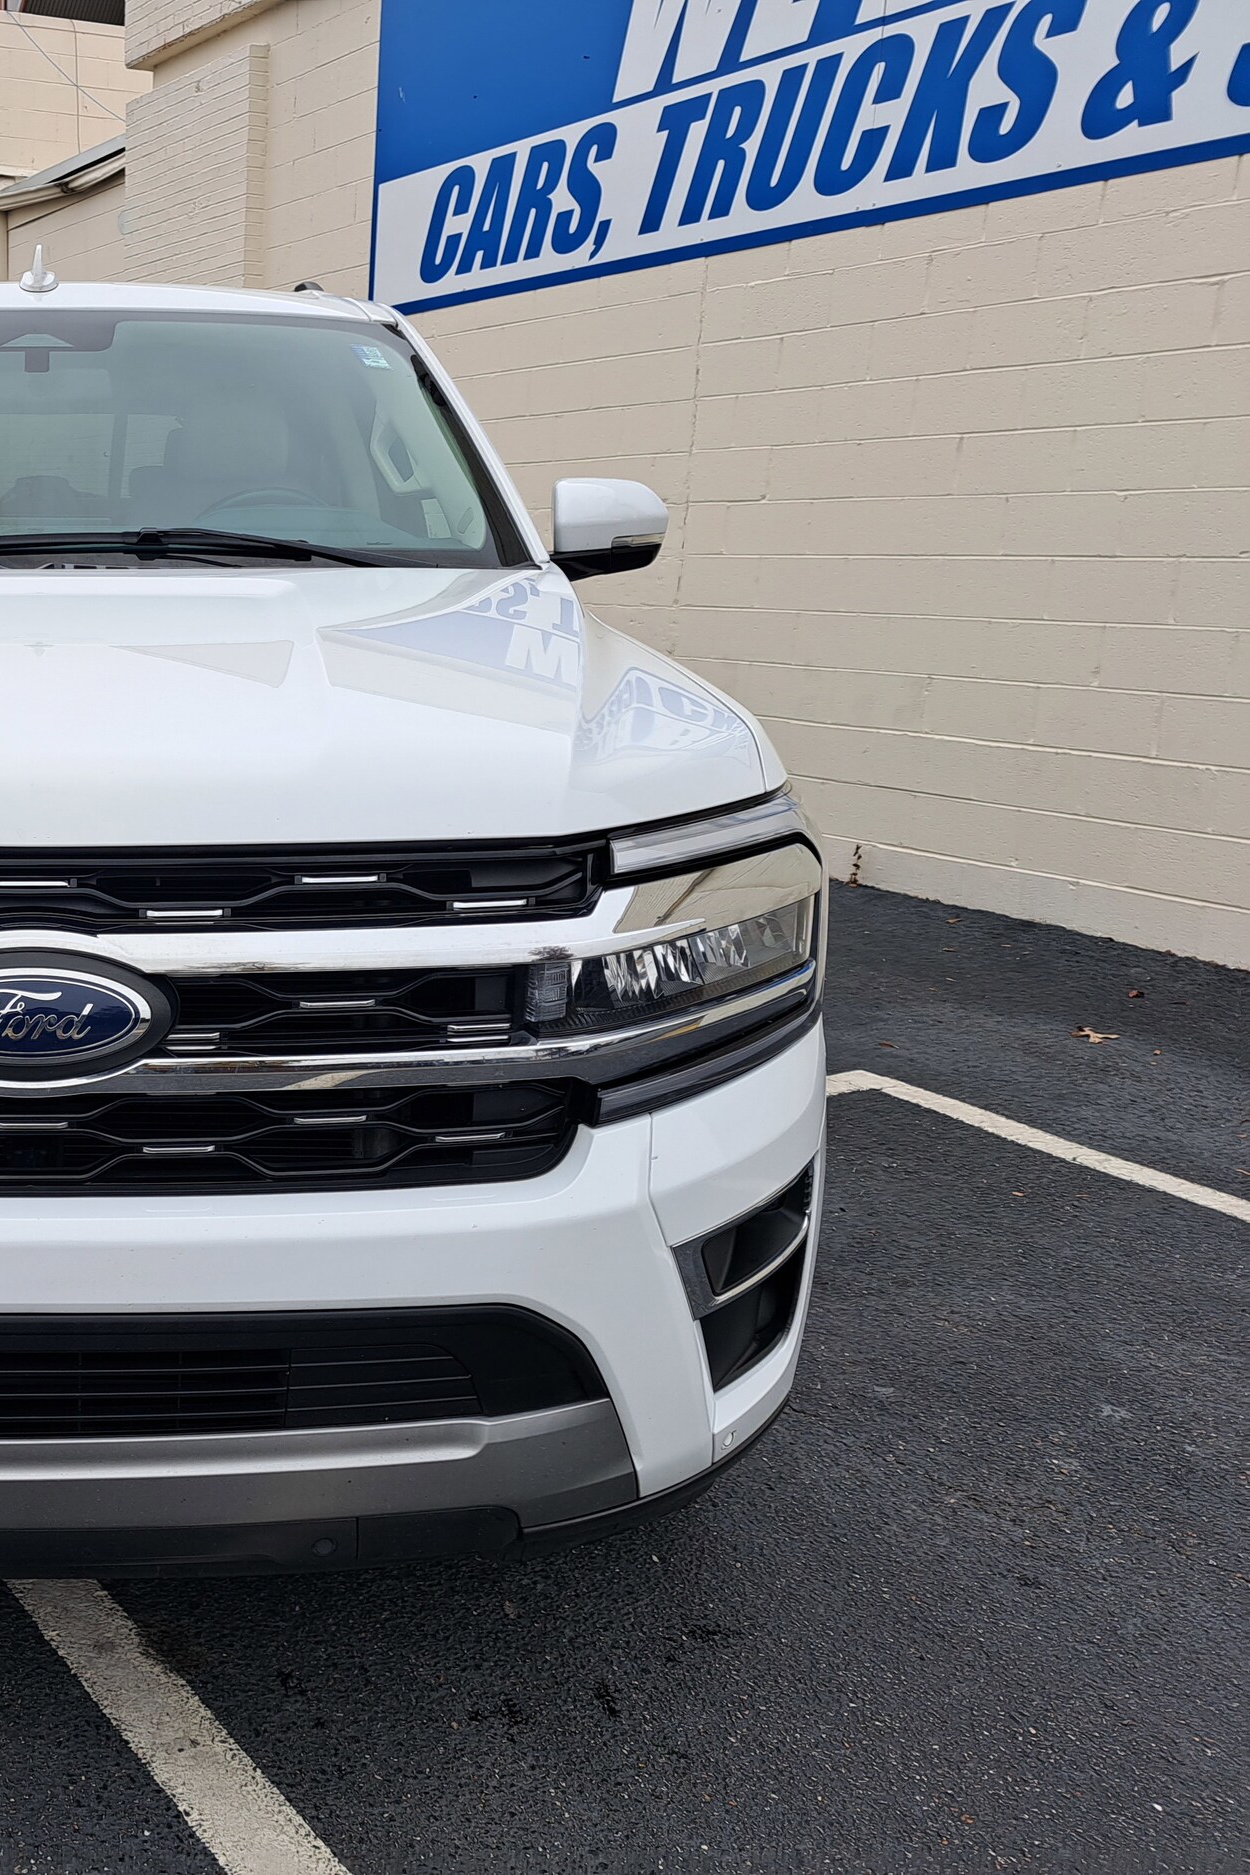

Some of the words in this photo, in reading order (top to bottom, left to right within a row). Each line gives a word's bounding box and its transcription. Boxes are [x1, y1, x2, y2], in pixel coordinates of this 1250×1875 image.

[419, 121, 618, 284] CARS,
[638, 0, 1088, 236] TRUCKS
[1080, 0, 1200, 141] &
